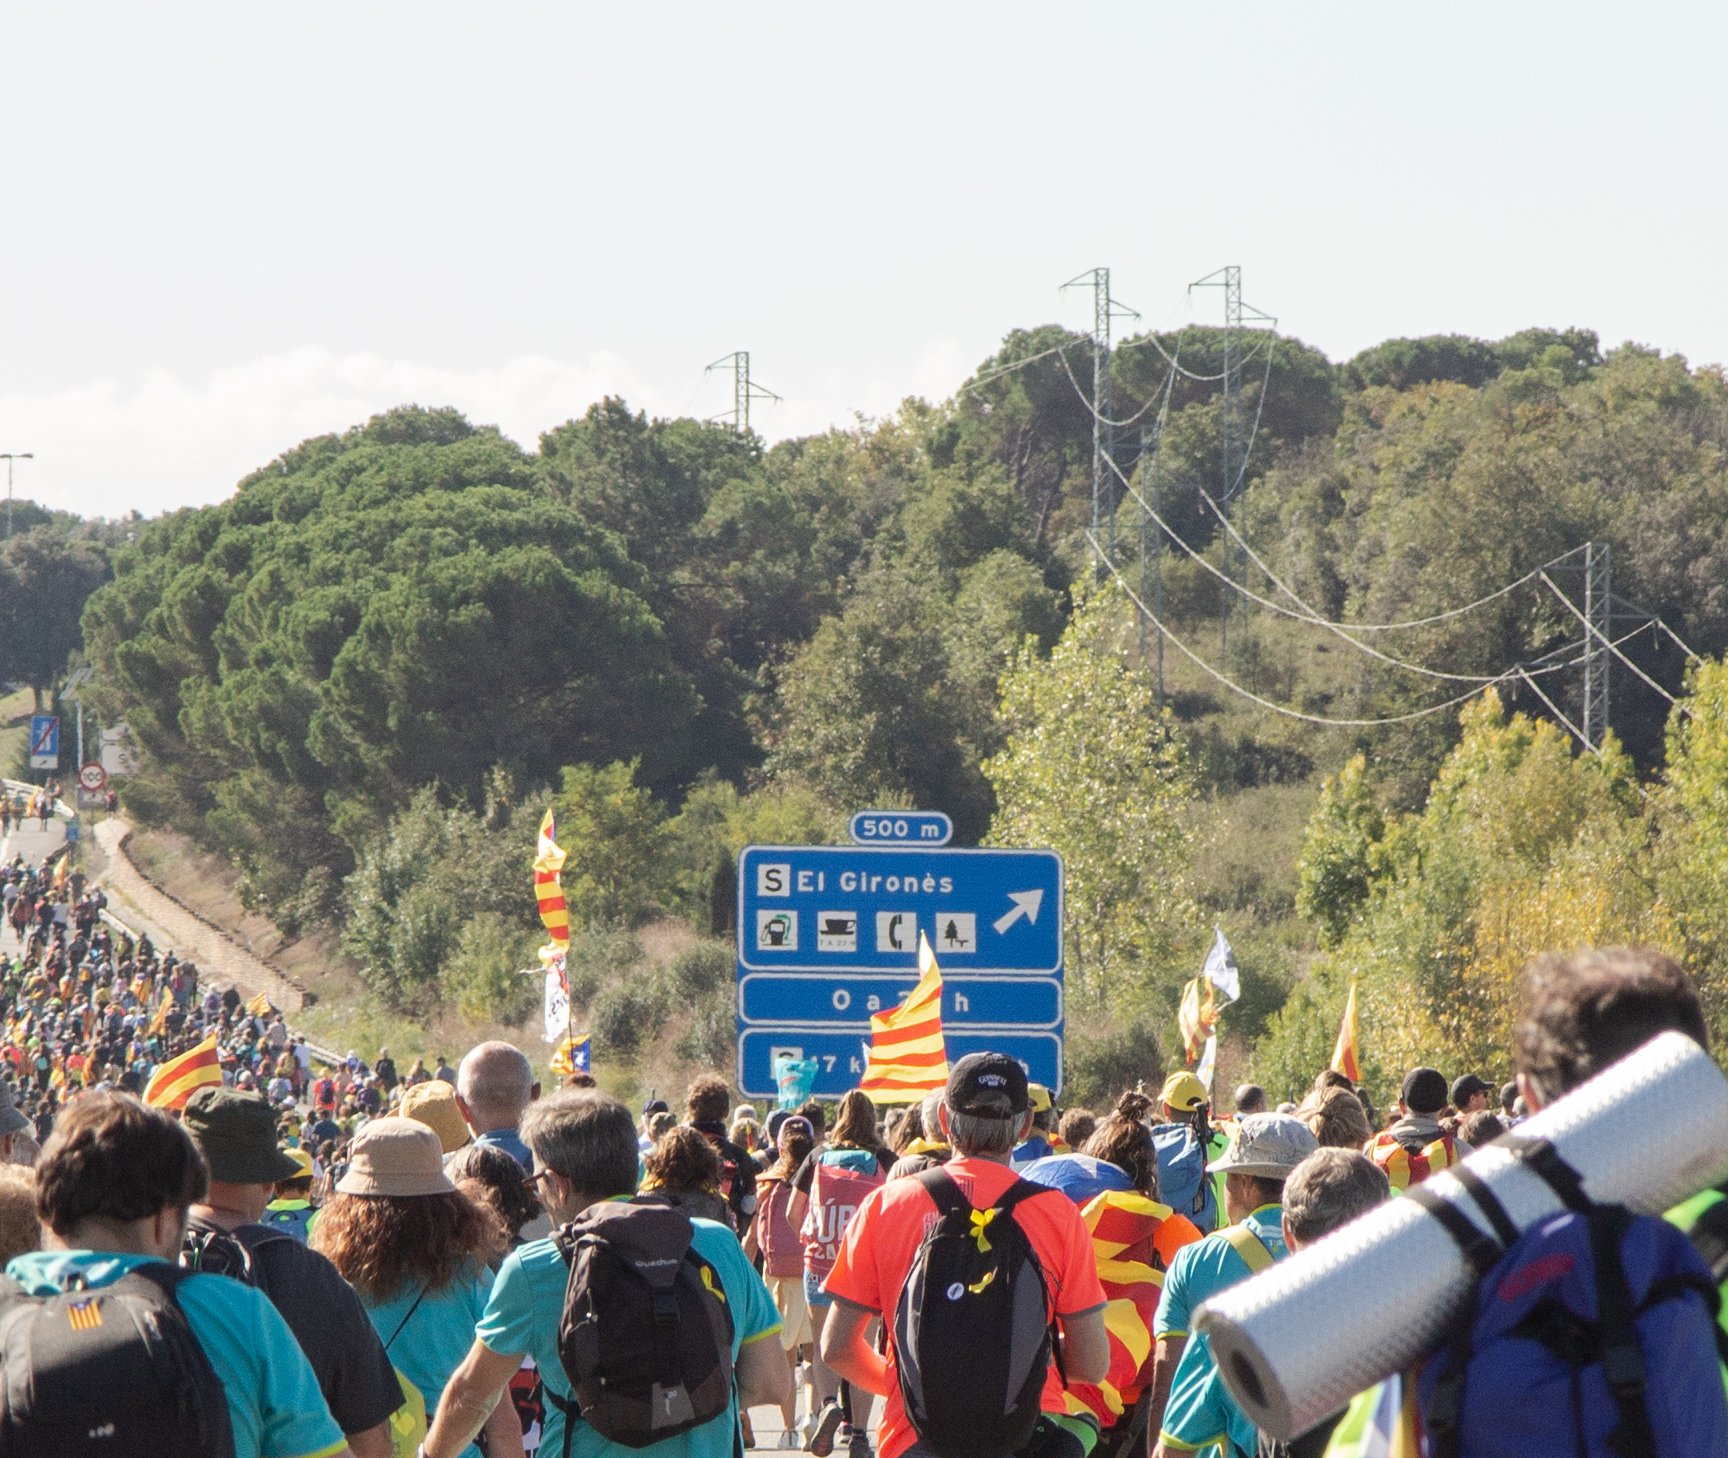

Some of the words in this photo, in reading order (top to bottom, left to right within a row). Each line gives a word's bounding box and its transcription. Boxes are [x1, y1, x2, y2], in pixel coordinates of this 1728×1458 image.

[863, 820, 909, 838] 500
[921, 823, 940, 838] m
[797, 871, 825, 893] El
[840, 872, 954, 894] Gironès
[866, 994, 881, 1011] a
[954, 992, 969, 1012] h
